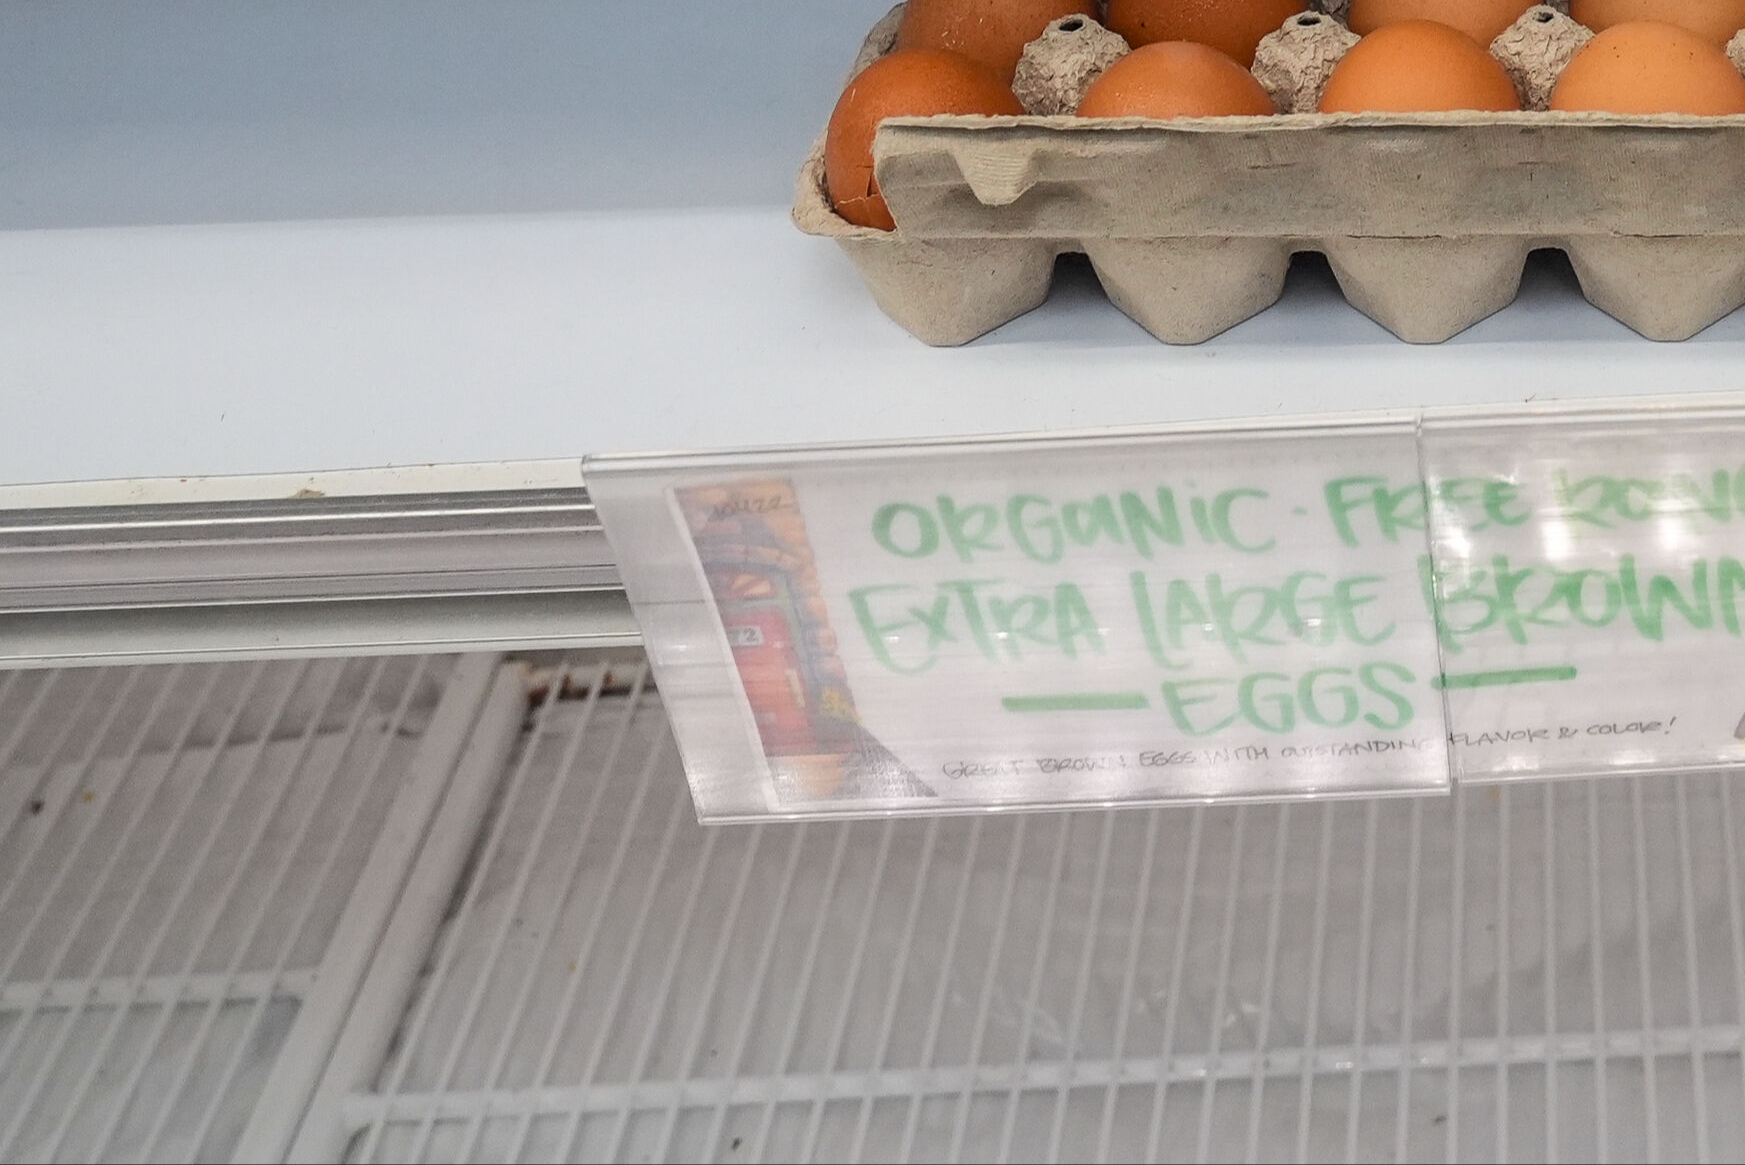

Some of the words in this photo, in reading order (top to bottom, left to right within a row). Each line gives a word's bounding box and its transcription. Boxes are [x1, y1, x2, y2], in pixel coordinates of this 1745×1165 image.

[1322, 475, 1531, 547] FREE
[847, 578, 1107, 674] EXTRA
[1129, 570, 1397, 670] LARGE
[1161, 661, 1417, 737] EGGS
[943, 759, 1024, 779] GRET
[1138, 750, 1196, 767] EGGS
[1449, 729, 1549, 746] FLAVOR
